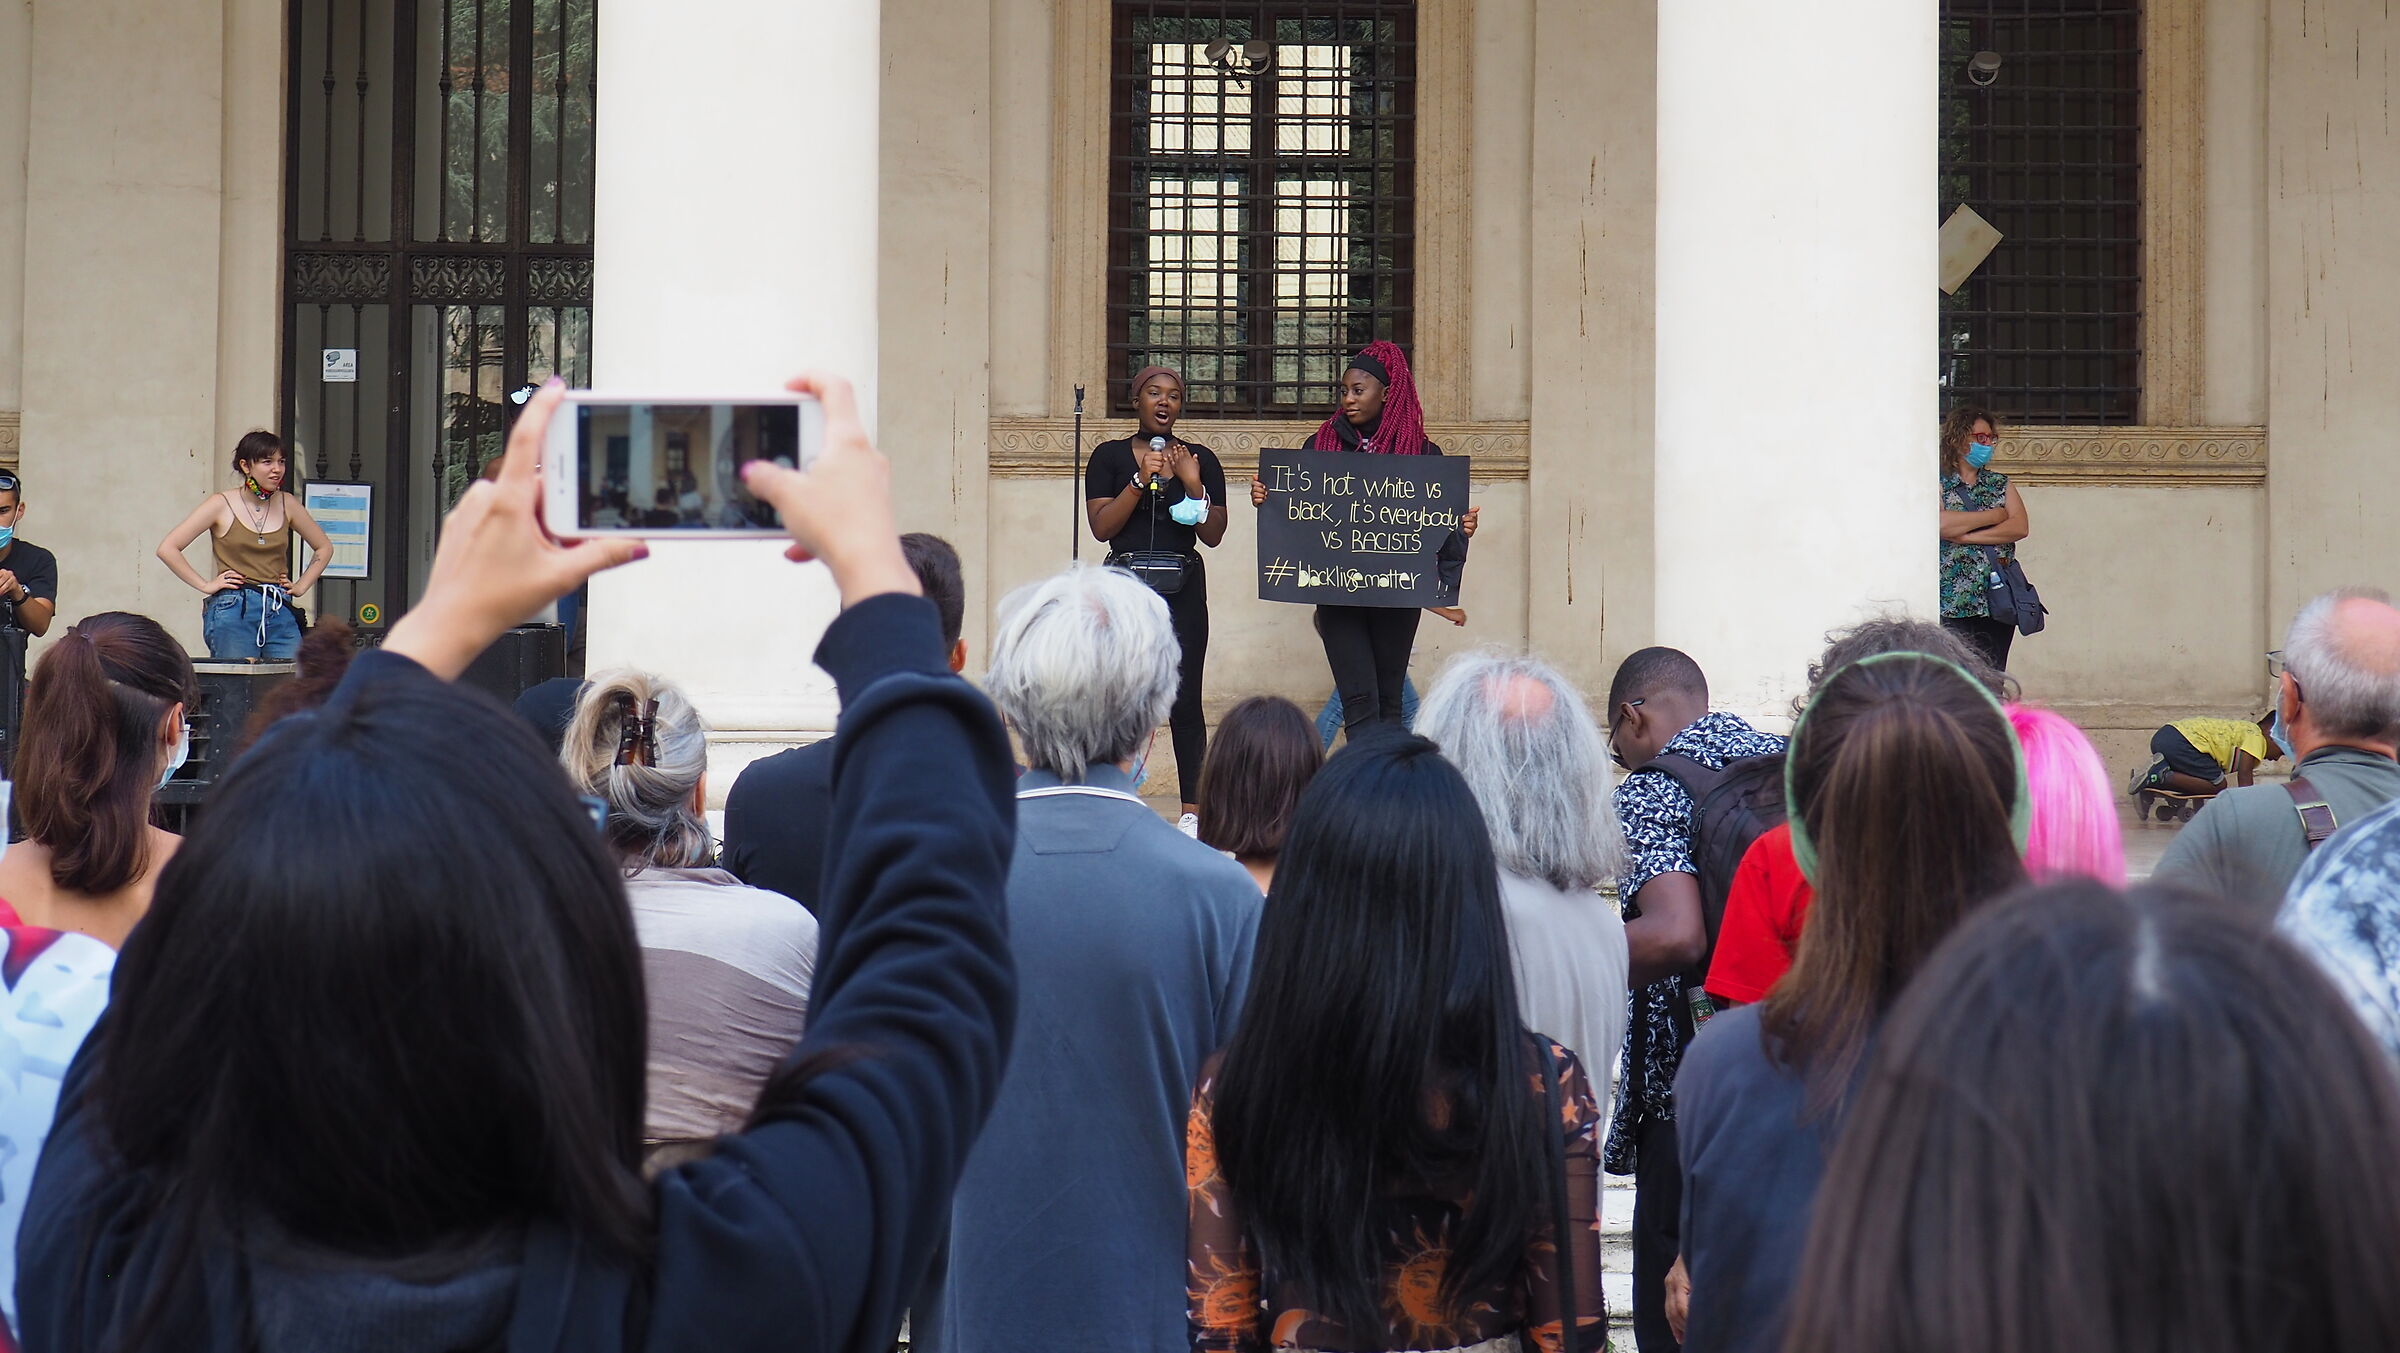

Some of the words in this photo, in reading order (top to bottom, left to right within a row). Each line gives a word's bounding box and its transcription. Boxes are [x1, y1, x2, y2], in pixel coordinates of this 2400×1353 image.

[1268, 464, 1312, 493] It's
[1362, 477, 1416, 499] white
[1288, 498, 1343, 528] black,
[1379, 506, 1459, 533] everybody
[1351, 530, 1422, 551] RACISTS
